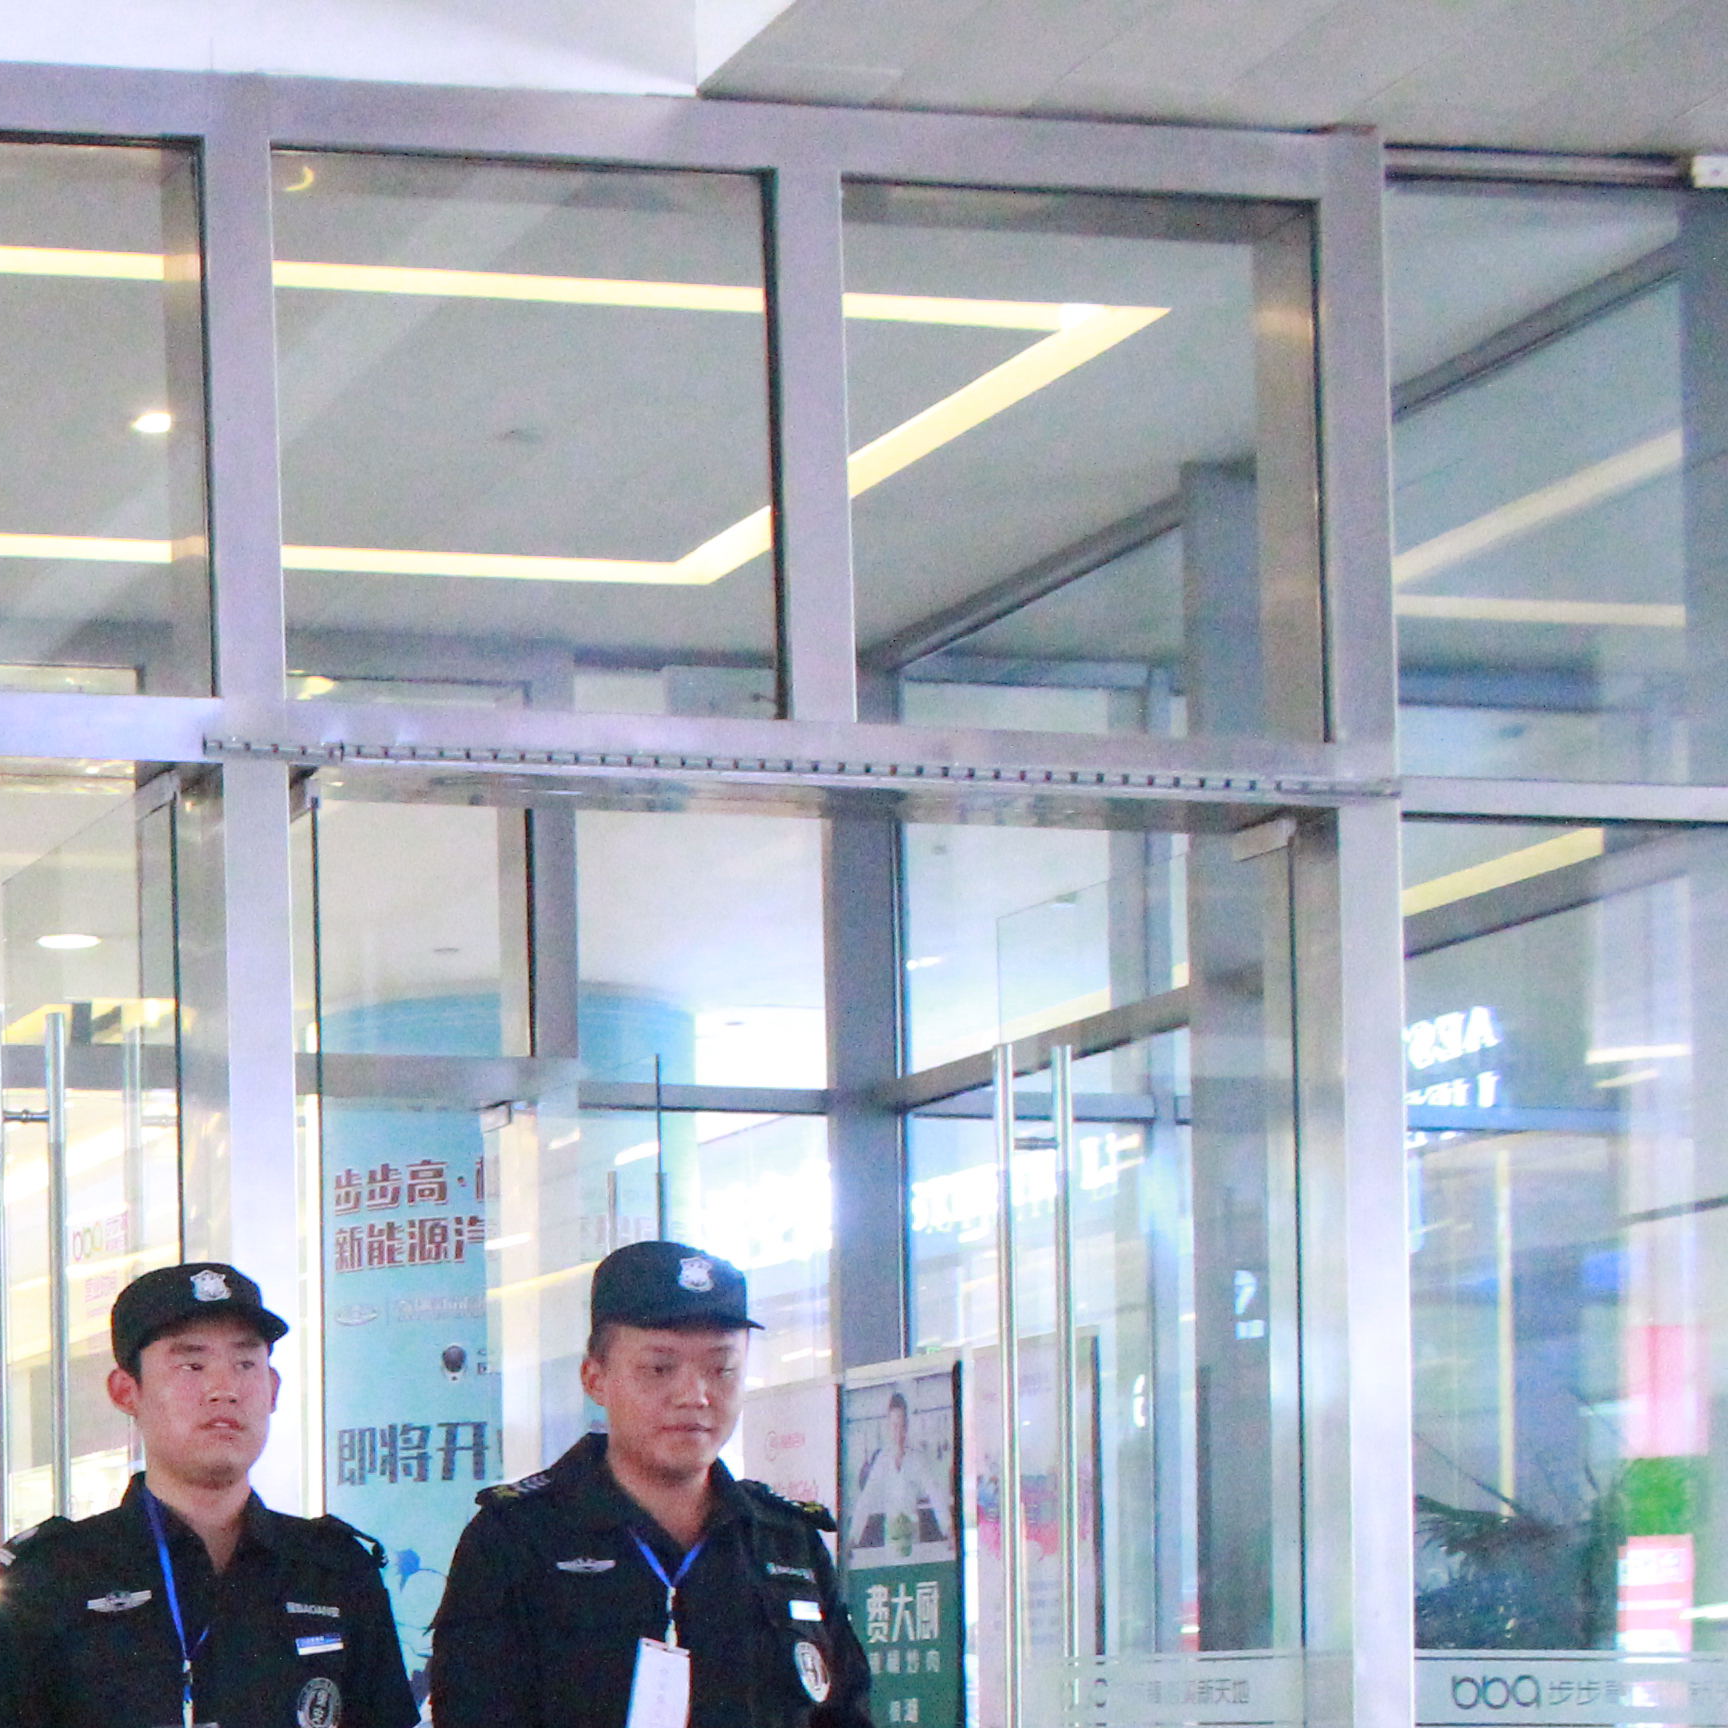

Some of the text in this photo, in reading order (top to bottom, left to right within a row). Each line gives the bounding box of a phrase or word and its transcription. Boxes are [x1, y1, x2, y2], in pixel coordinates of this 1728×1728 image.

[334, 1158, 486, 1217] 步步高·
[337, 1420, 502, 1487] 即将开
